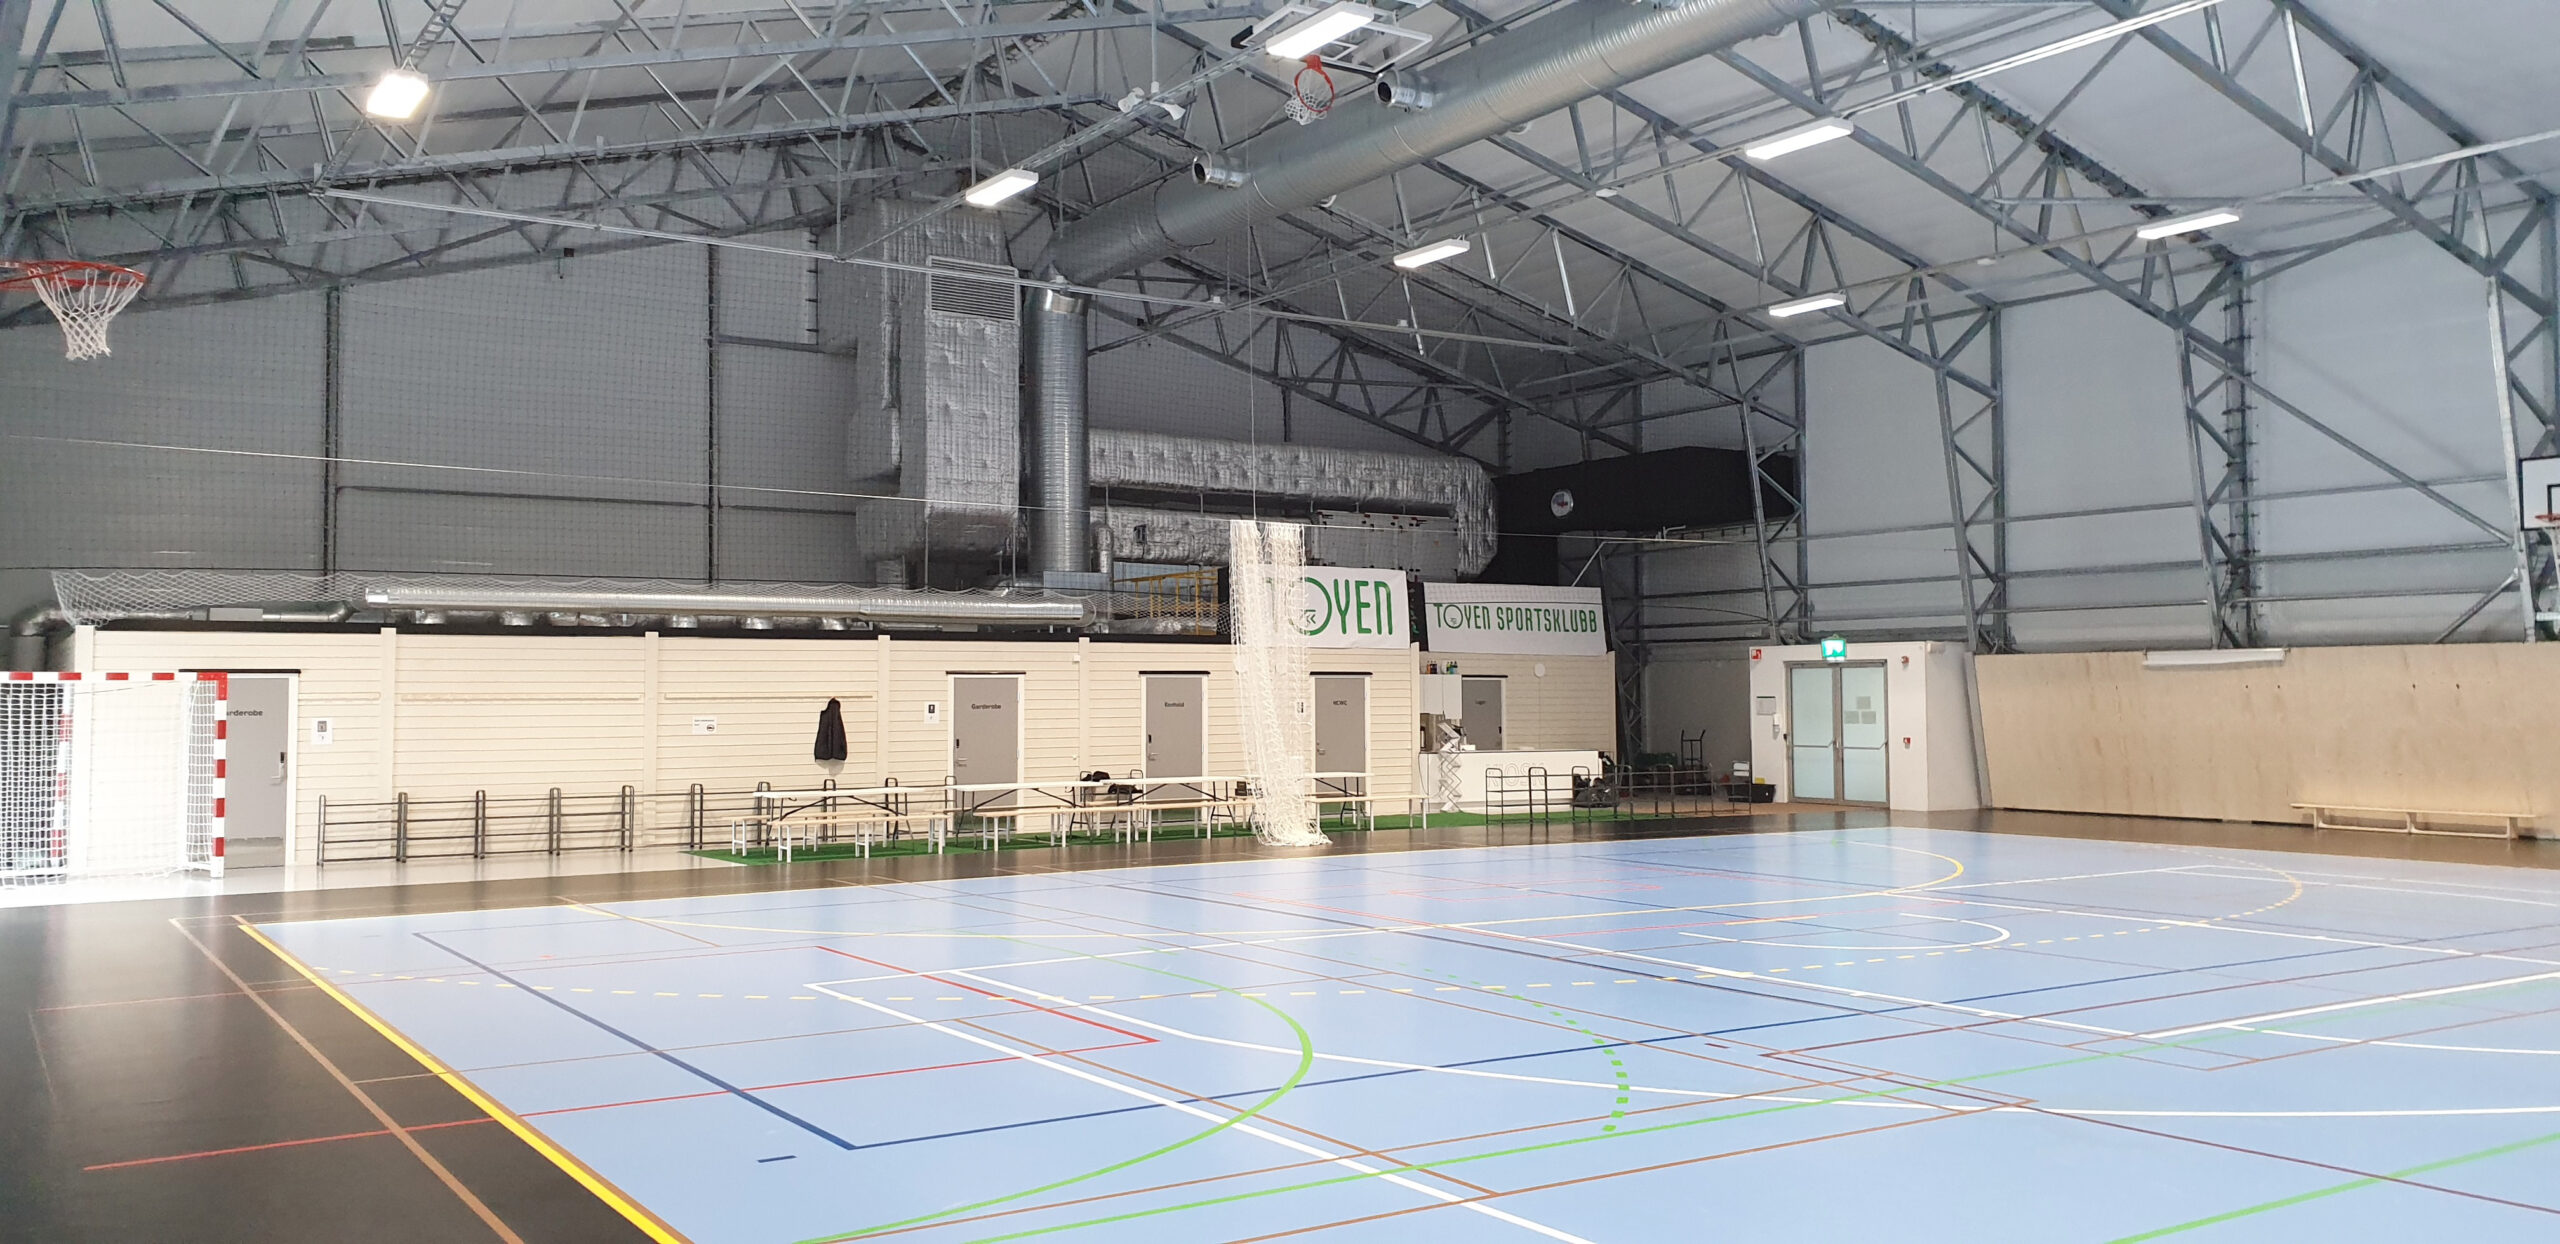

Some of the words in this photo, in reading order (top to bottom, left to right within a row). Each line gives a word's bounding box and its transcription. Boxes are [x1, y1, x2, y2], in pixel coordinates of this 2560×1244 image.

[1265, 576, 1393, 636] OYEN
[1496, 607, 1598, 633] SPORTSKLUBB
[226, 709, 264, 717] arderobe
[1485, 763, 1545, 788] KOSK
